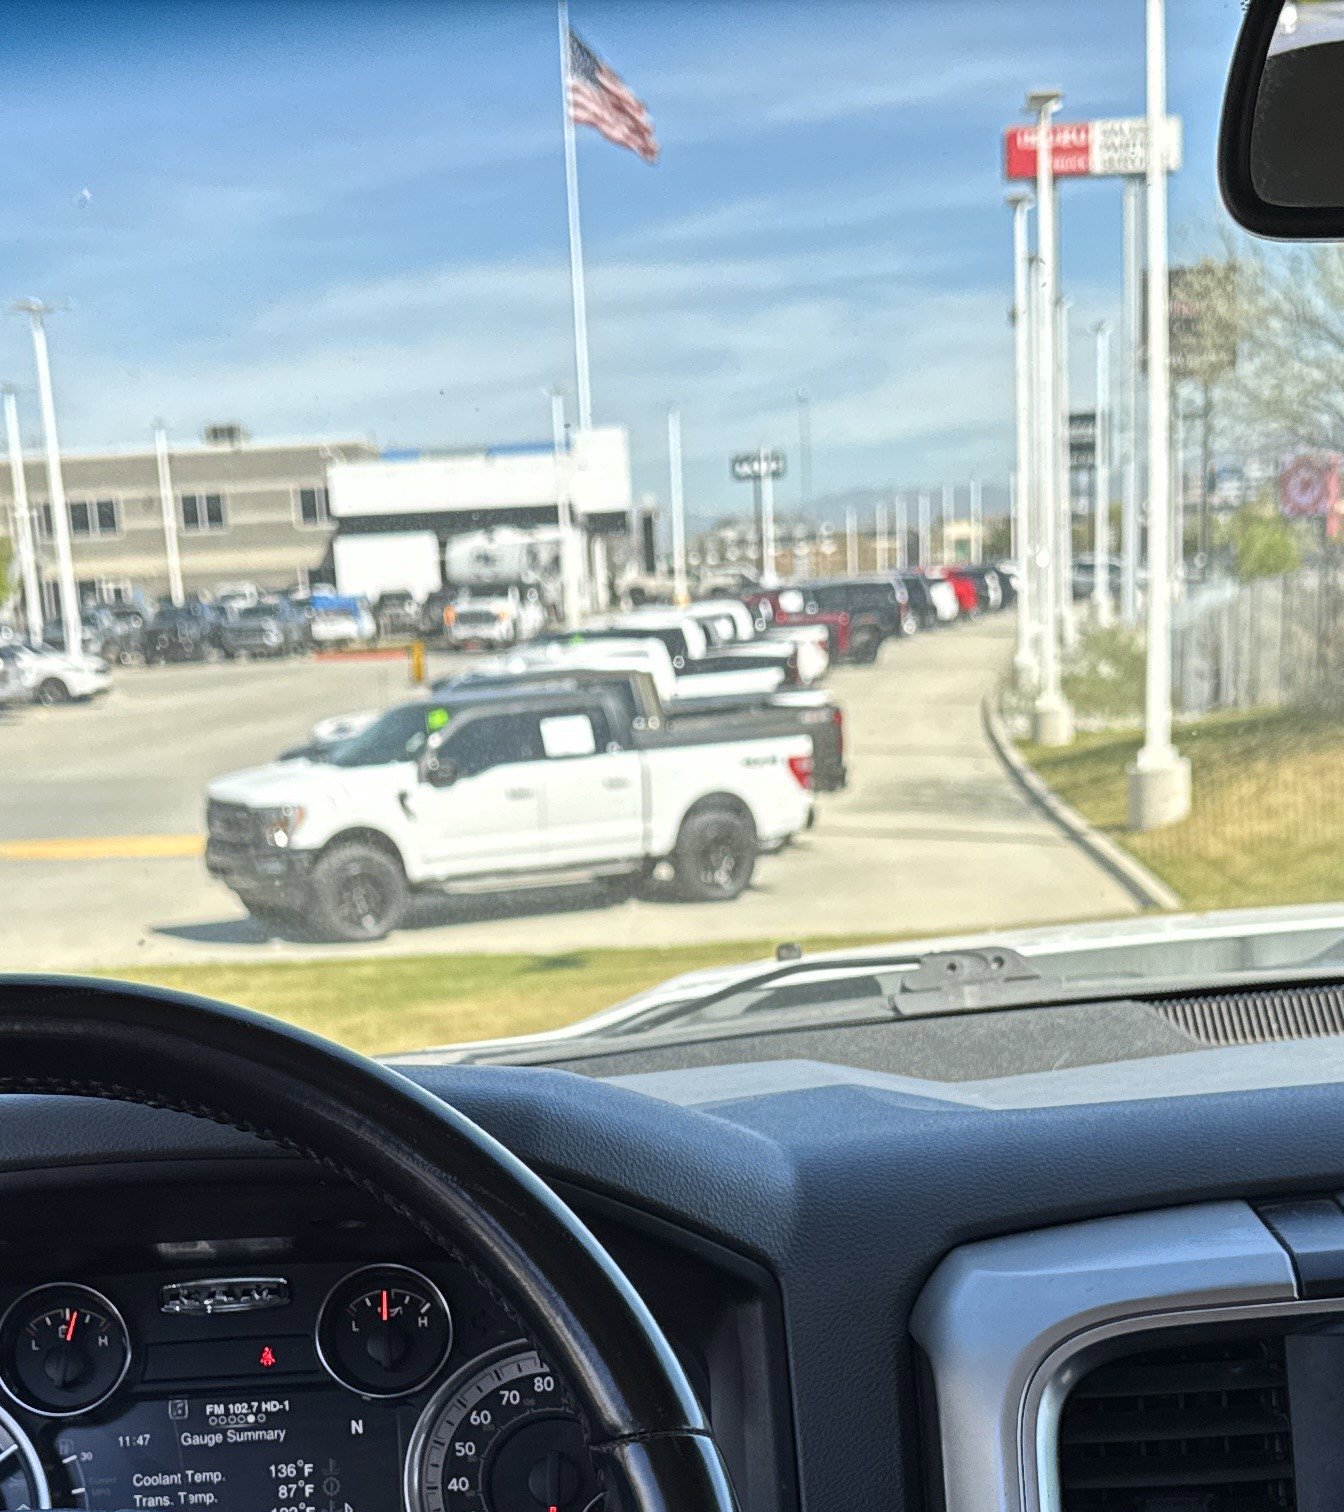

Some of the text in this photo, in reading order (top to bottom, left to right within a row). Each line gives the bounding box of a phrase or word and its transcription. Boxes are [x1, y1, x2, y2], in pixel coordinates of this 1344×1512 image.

[534, 1376, 554, 1392] 80
[499, 1390, 521, 1406] 70
[205, 1399, 290, 1416] FM 102.7 HD-1
[470, 1410, 491, 1426] 60
[350, 1419, 364, 1436] N
[118, 1434, 150, 1447] 11:47
[180, 1428, 287, 1448] Gauge Summary
[455, 1441, 476, 1457] 50
[132, 1470, 182, 1487] Coolant
[186, 1470, 226, 1485] Temp.
[447, 1476, 470, 1493] 40
[133, 1494, 174, 1508] Trans.
[179, 1491, 218, 1506] Temp.
